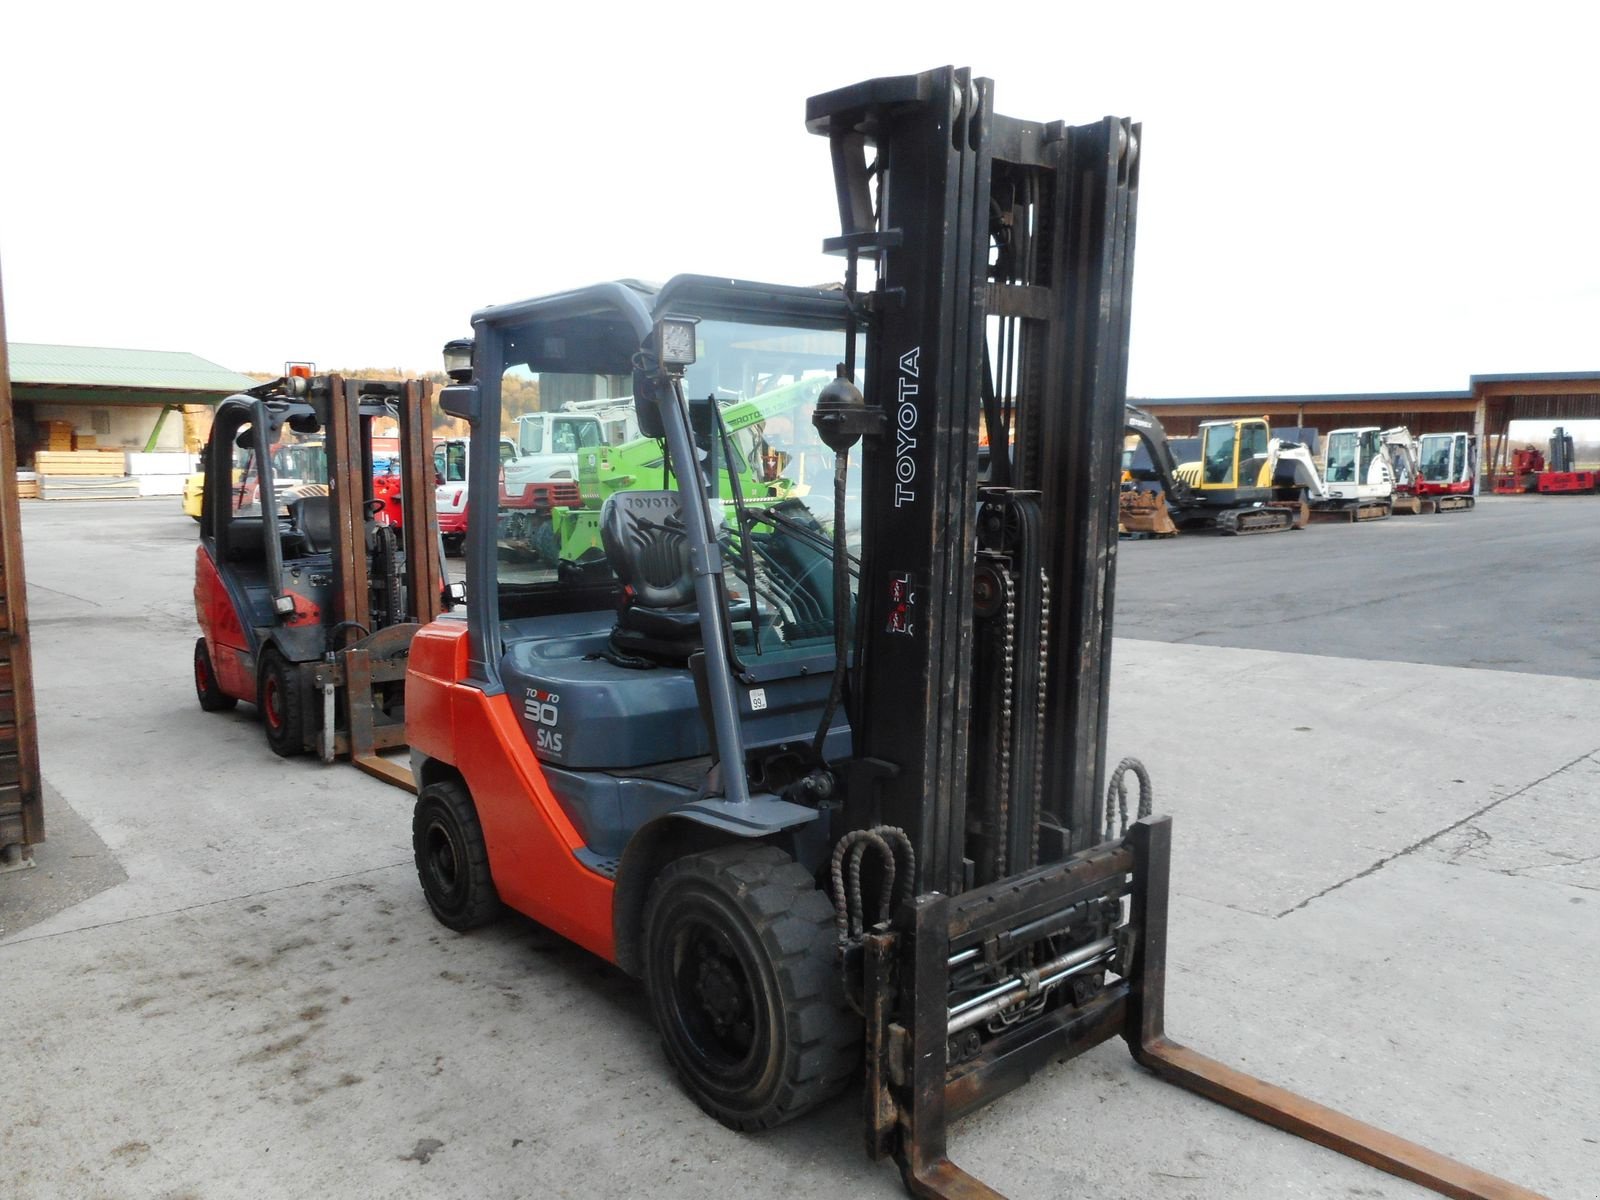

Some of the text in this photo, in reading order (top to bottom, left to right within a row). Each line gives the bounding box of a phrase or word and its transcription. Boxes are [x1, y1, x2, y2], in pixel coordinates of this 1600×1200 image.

[895, 346, 920, 508] TOYOTA
[524, 698, 558, 727] 30
[537, 728, 563, 752] SAS
